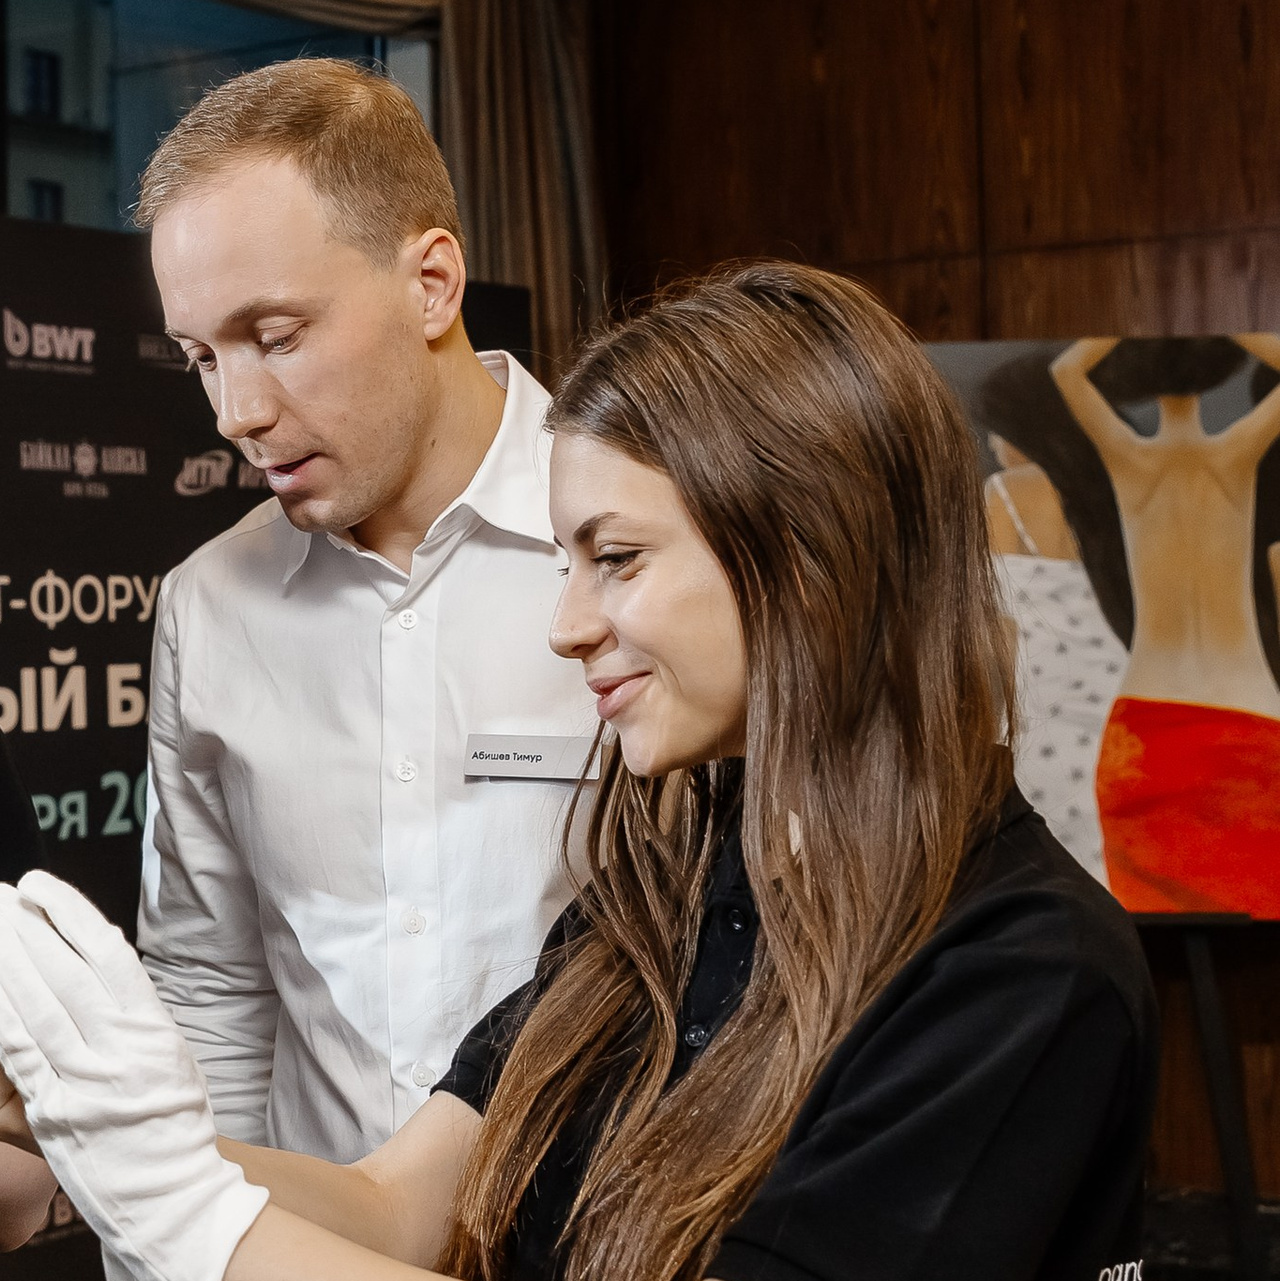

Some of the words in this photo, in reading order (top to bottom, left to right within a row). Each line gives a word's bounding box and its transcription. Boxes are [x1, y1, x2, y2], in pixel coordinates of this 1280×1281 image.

[31, 322, 96, 363] BWT
[106, 663, 150, 728] Б
[472, 751, 510, 761] Абишев
[512, 752, 543, 763] Тимур
